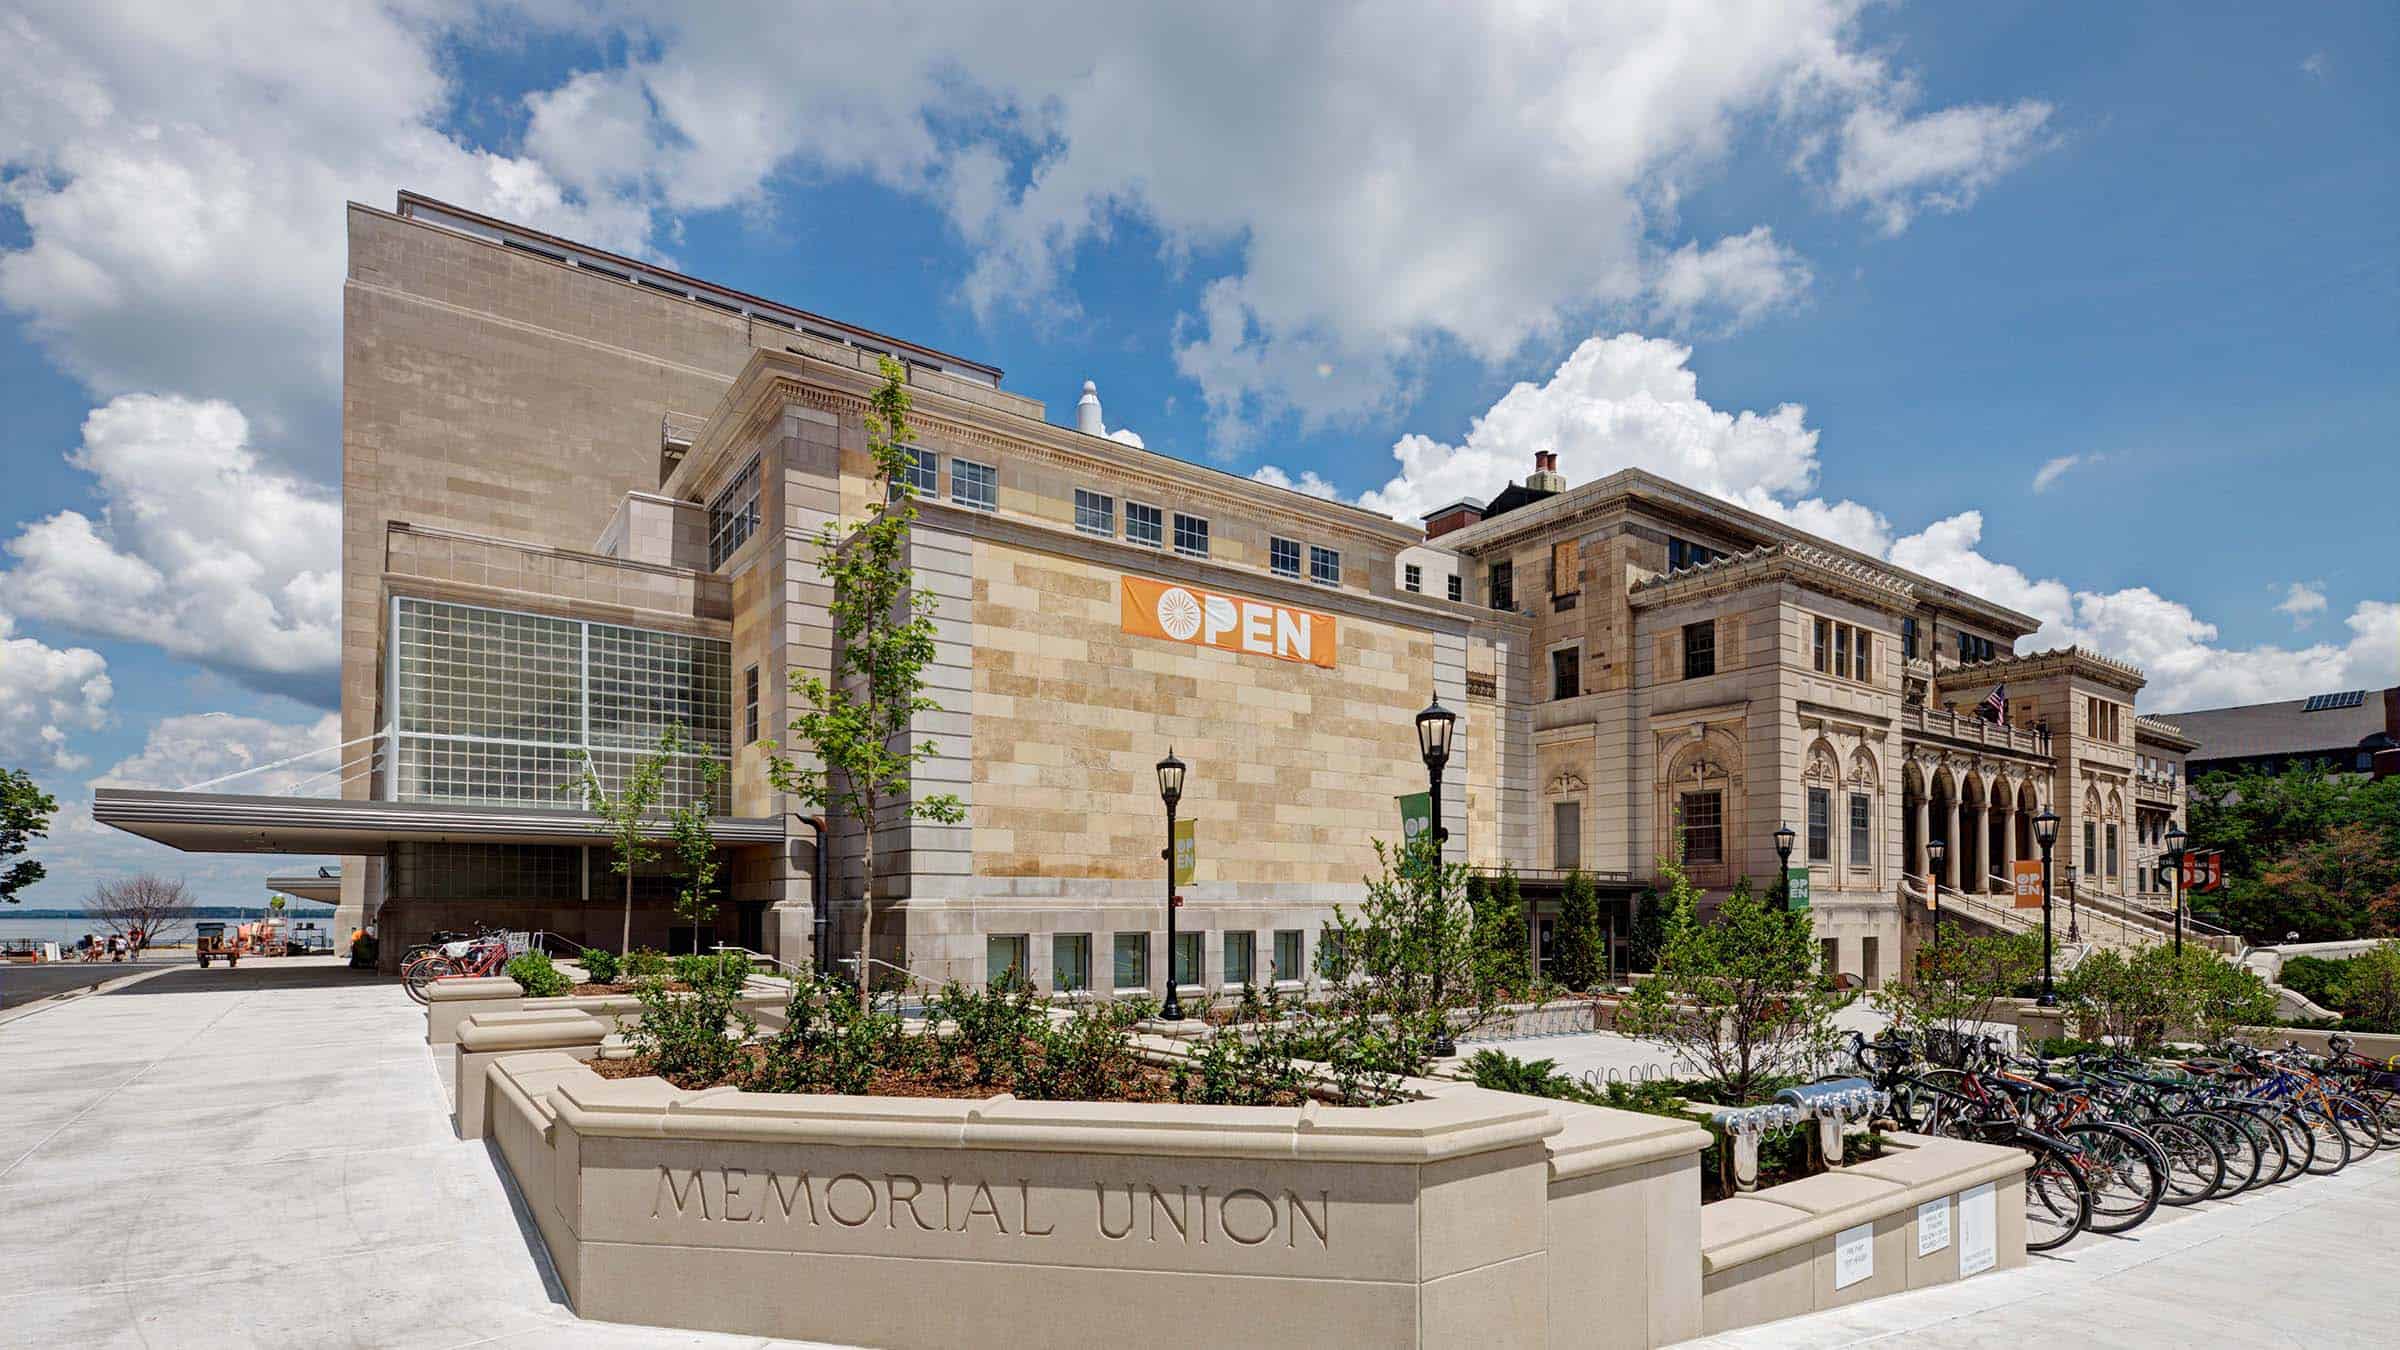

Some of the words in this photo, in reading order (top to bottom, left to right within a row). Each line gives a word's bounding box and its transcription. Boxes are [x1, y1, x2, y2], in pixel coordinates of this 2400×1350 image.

[1157, 587, 1311, 660] OPEN
[1791, 879, 1808, 888] OP
[2016, 872, 2040, 885] OP
[1791, 889, 1808, 898] EN
[2018, 885, 2040, 896] EN
[650, 1163, 1055, 1238] MEMORIAL
[1094, 1177, 1328, 1252] UNION
